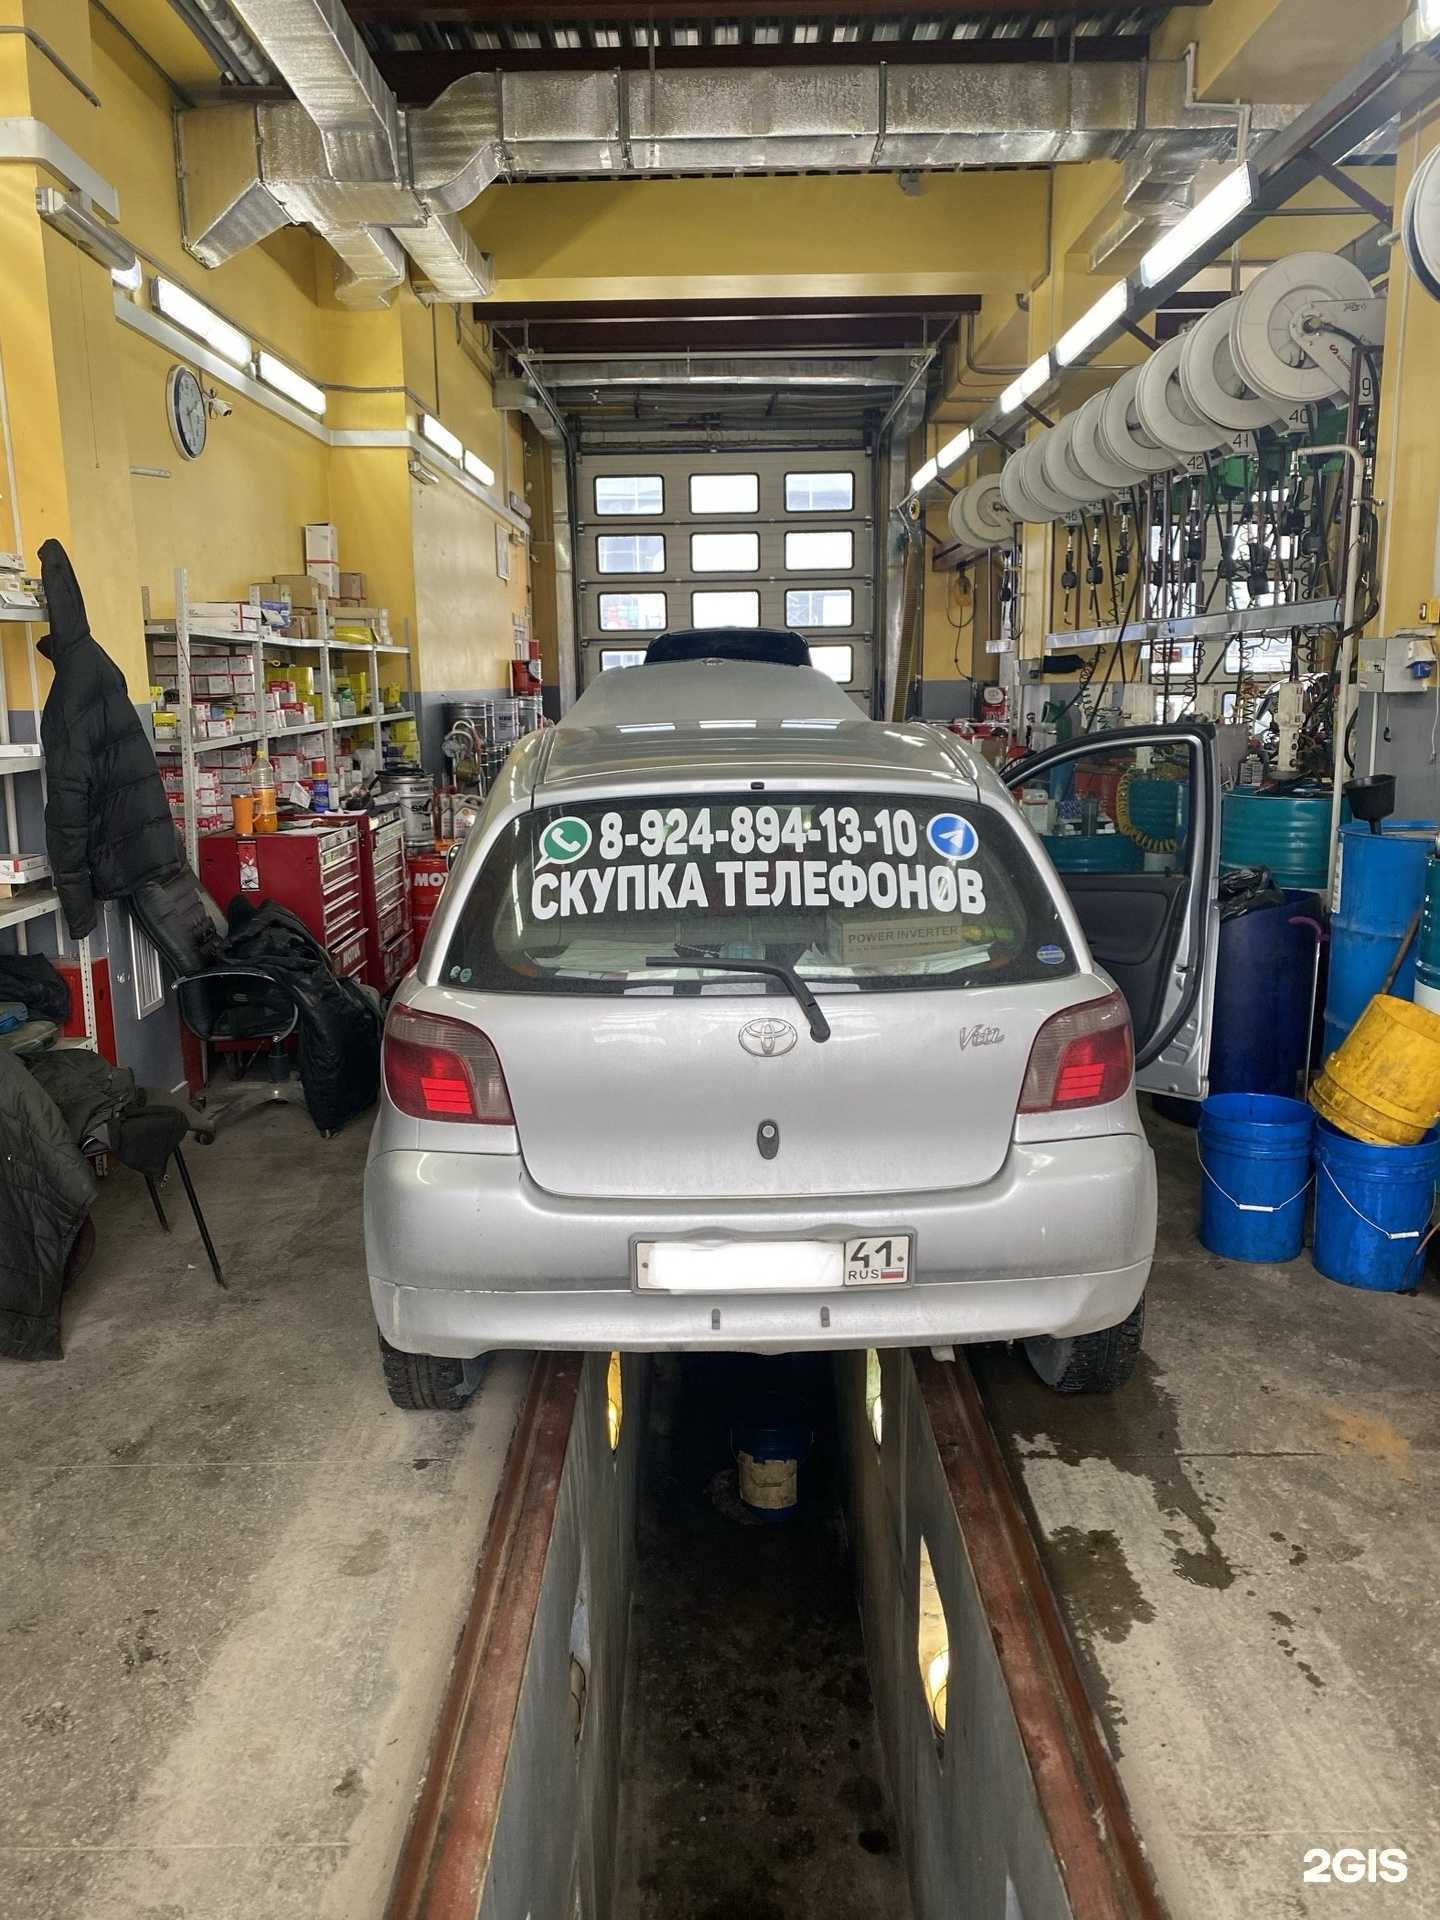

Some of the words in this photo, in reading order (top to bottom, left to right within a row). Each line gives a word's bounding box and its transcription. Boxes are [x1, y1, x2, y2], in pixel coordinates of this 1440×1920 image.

[1232, 433, 1249, 448] 41
[1187, 455, 1204, 470] 42
[599, 806, 917, 860] 8-924-894-13-10
[531, 862, 709, 920] СКУПКА
[715, 859, 986, 915] ТЕЛЕФОНОВ
[848, 931, 894, 944] POWER
[897, 926, 960, 940] INVERTER
[850, 1240, 893, 1268] 41
[848, 1268, 880, 1281] RUS
